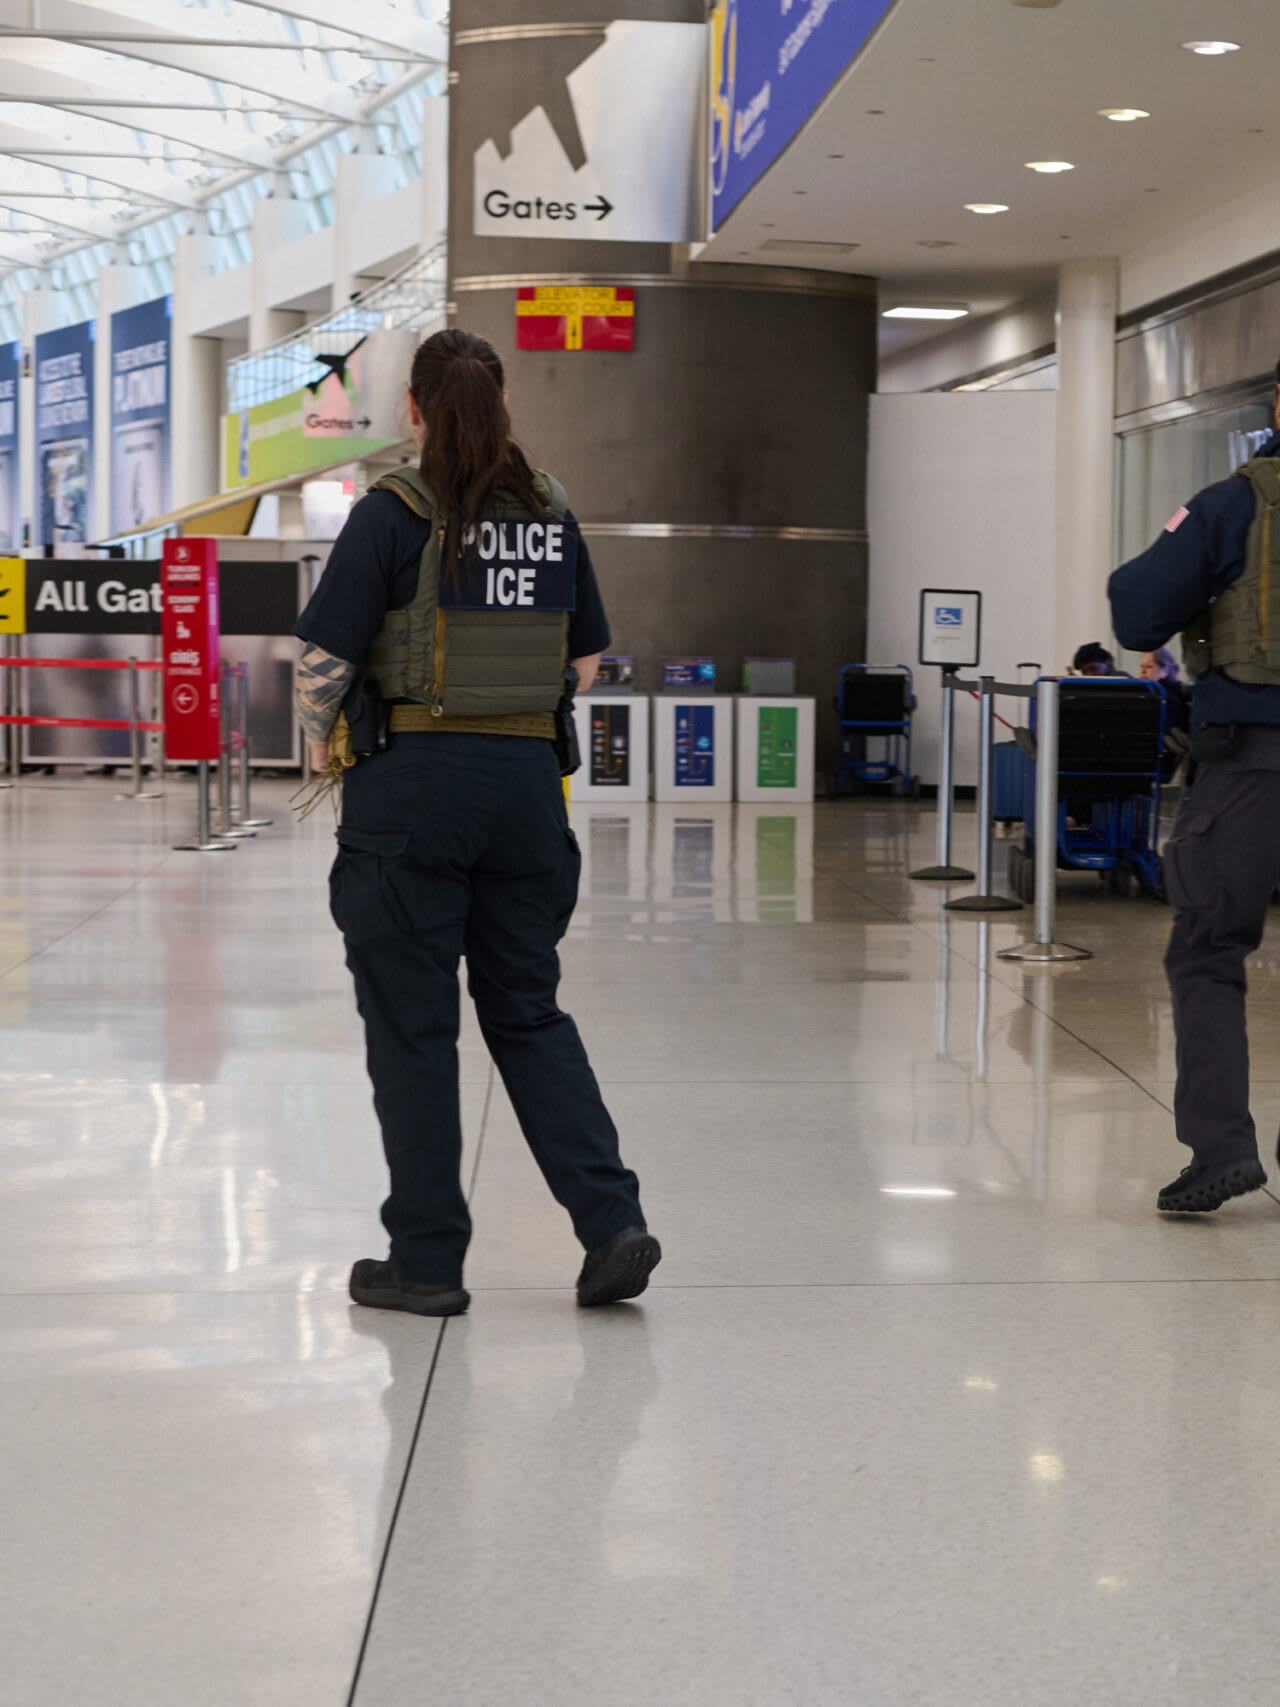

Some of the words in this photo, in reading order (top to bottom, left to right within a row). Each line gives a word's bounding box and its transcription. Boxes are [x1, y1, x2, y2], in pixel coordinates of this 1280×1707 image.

[484, 190, 577, 220] Gates
[520, 302, 536, 313] TO
[540, 302, 577, 313] FOOD
[582, 302, 632, 313] COURT
[537, 289, 610, 300] ELEVATOR
[306, 413, 354, 429] Gates
[458, 521, 563, 561] POLICE
[35, 580, 89, 612] All
[97, 580, 164, 613] Gat
[486, 567, 536, 606] ICE
